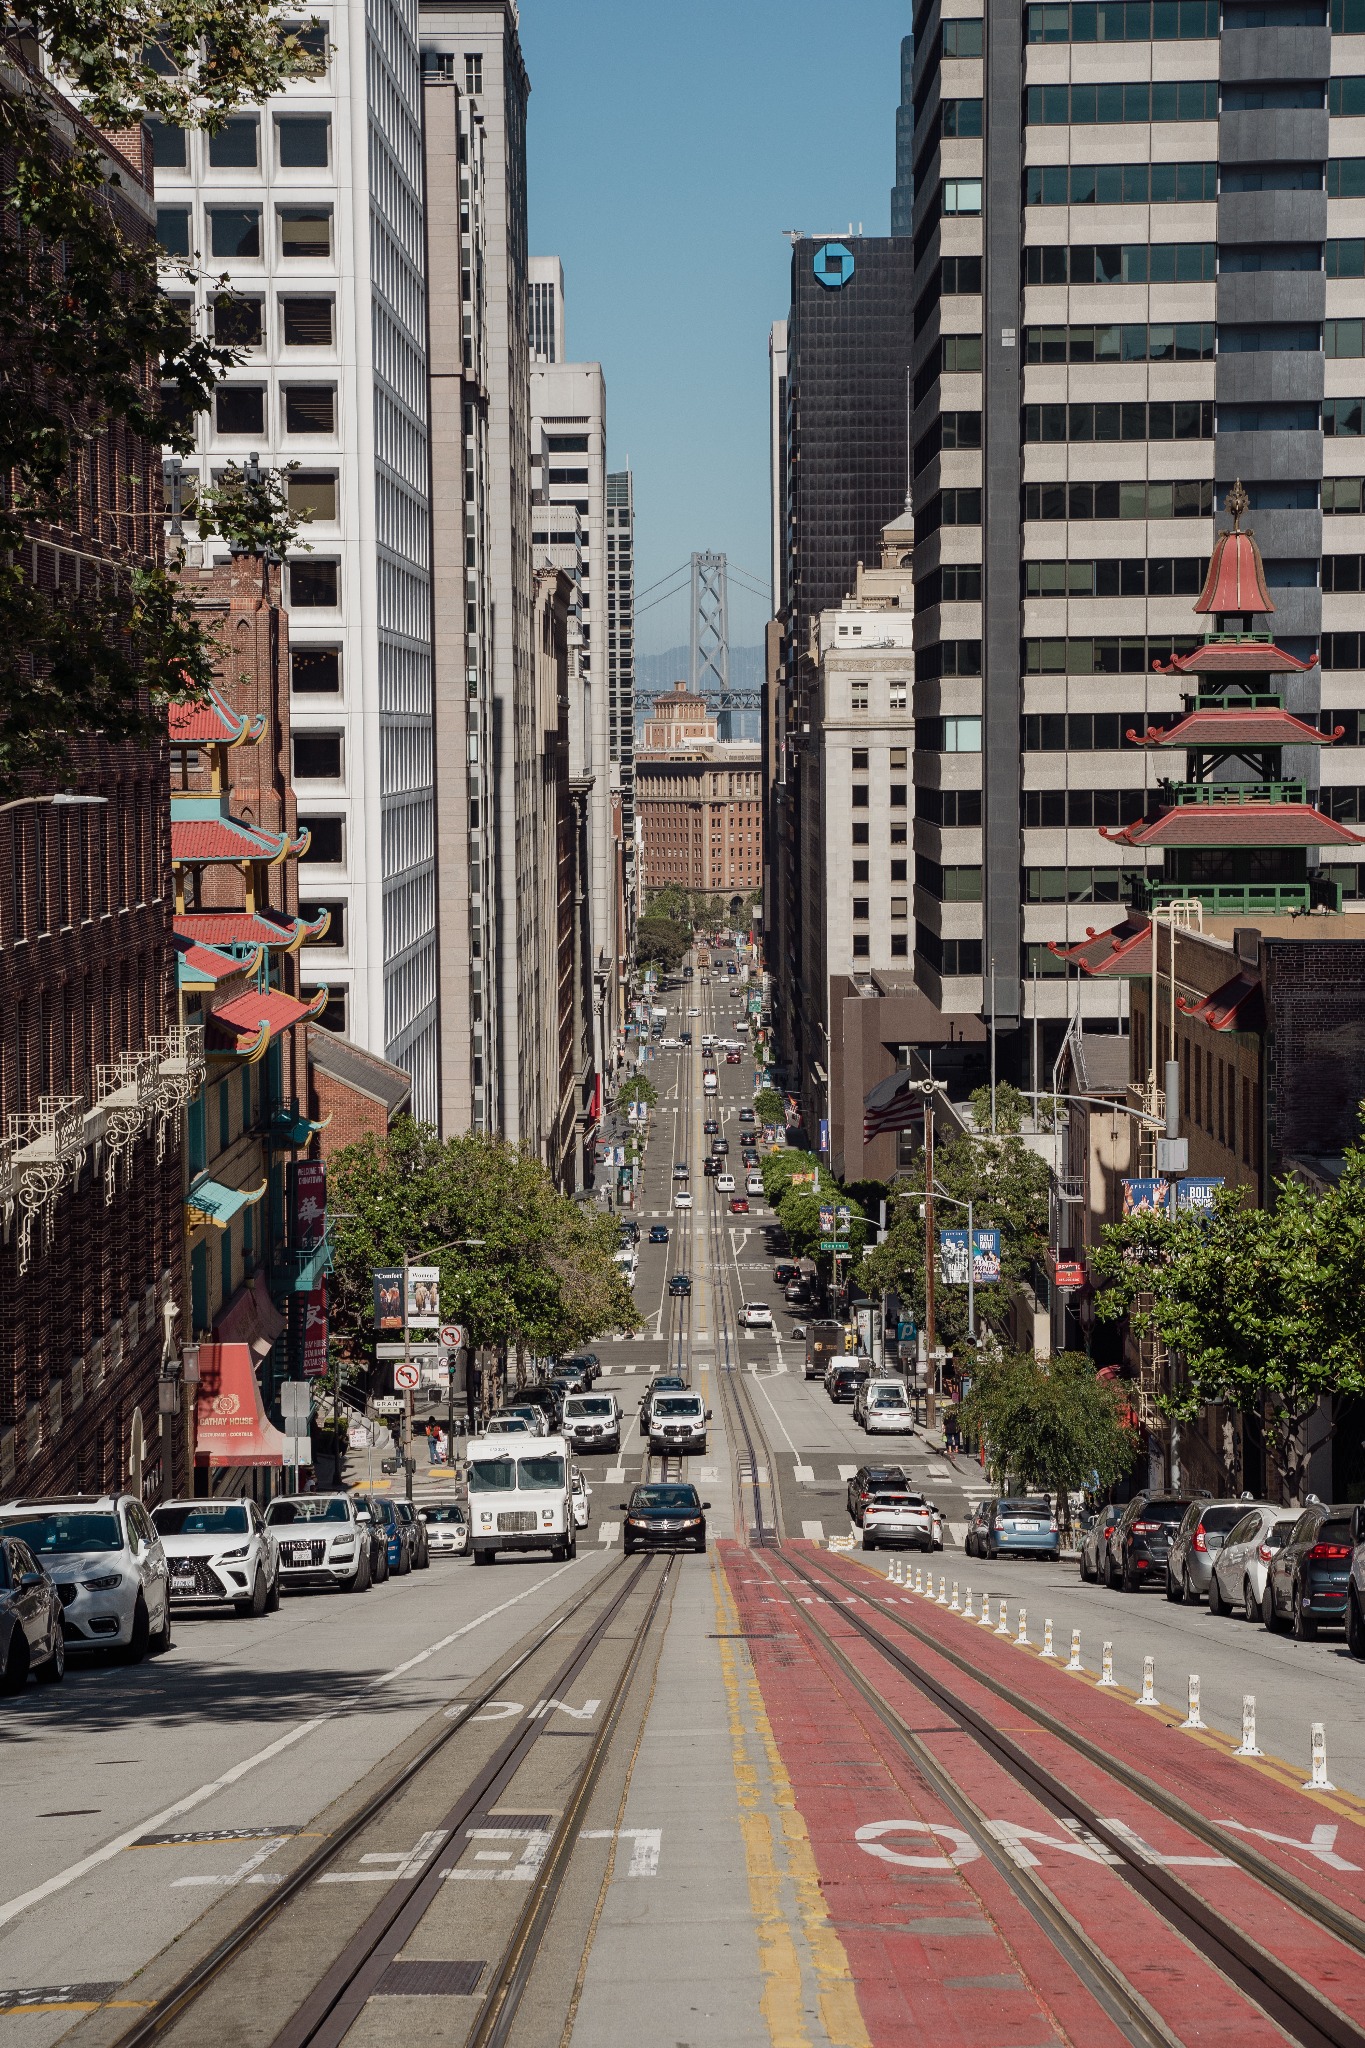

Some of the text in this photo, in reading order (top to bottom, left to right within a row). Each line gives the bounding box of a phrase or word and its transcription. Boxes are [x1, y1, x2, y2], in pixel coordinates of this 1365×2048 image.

[297, 1167, 317, 1176] WELCOME
[298, 1176, 323, 1185] CHINATOWN
[1189, 1186, 1213, 1199] BOLD
[980, 1234, 993, 1242] BOLD
[980, 1241, 993, 1250] NOW
[200, 1417, 254, 1426] CATHAY HOUSE
[855, 1818, 1363, 1872] ONLY
